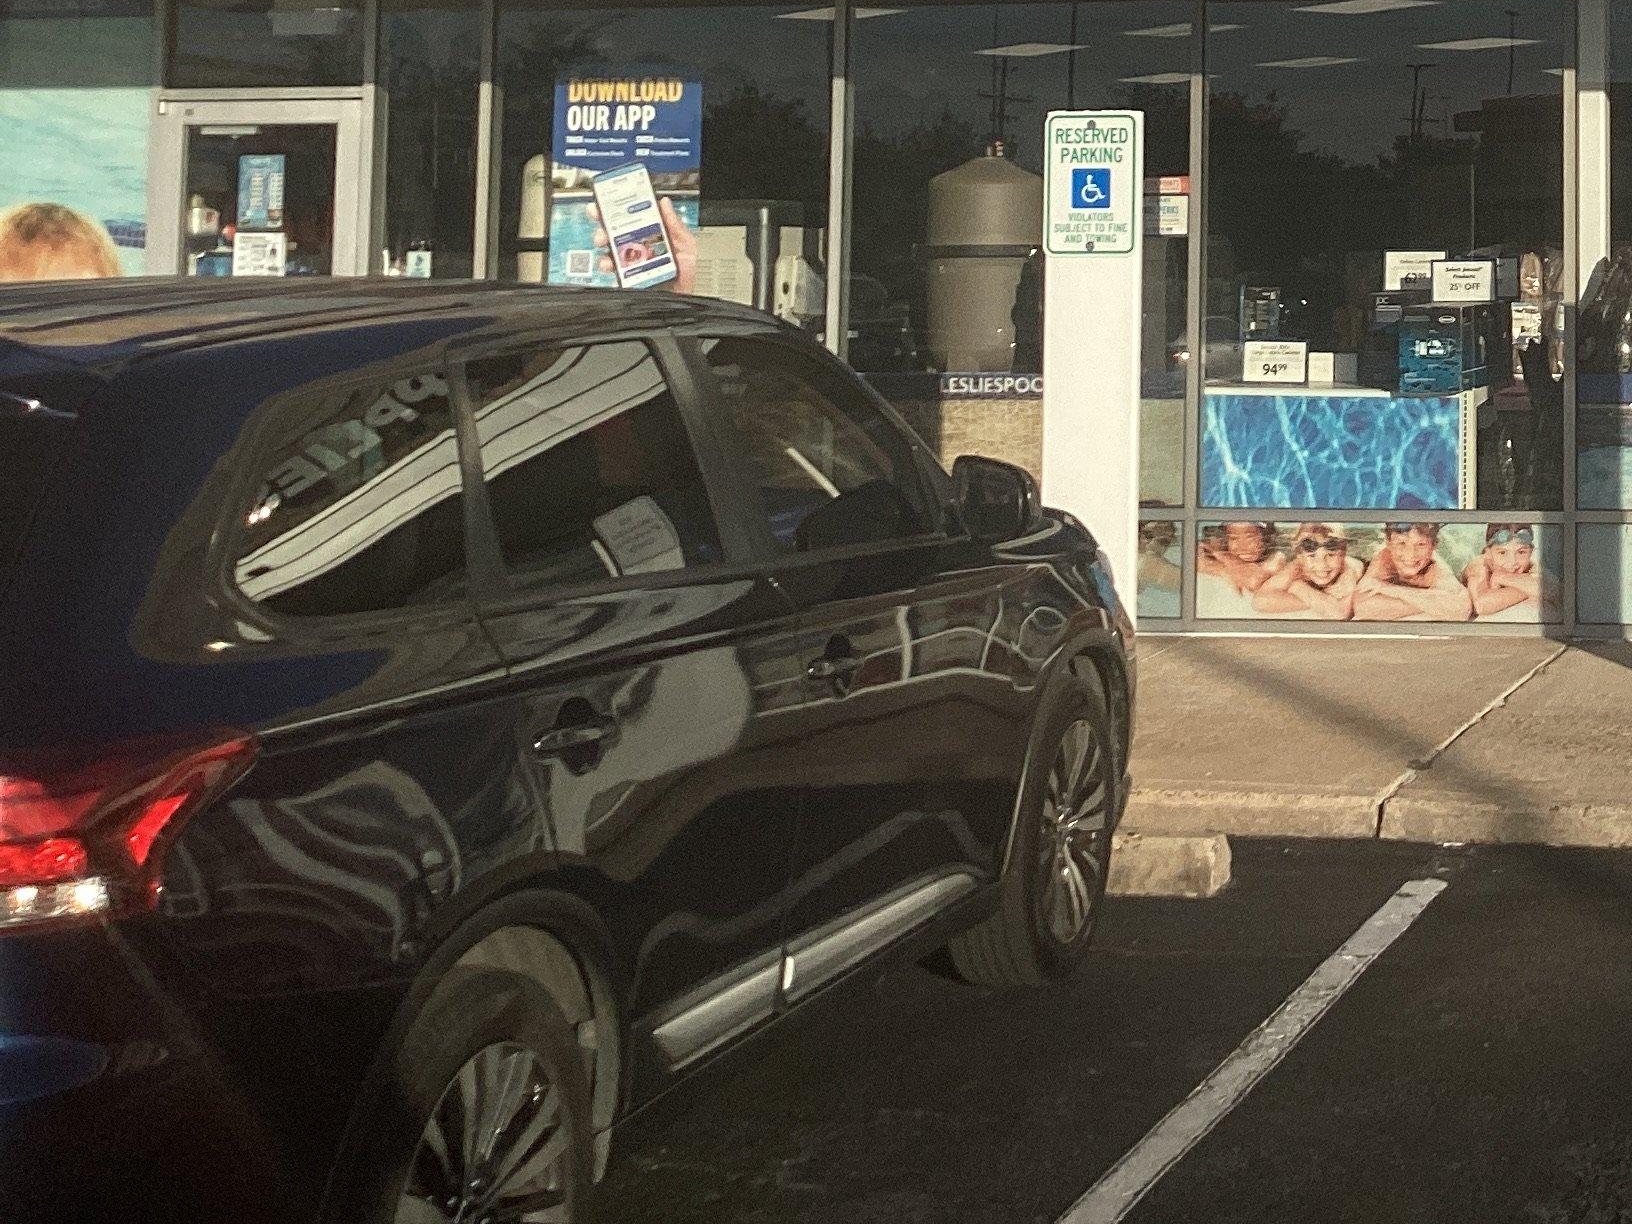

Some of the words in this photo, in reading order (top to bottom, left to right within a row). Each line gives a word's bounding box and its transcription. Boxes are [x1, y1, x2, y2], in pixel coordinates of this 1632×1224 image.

[568, 78, 684, 103] DOWNLOAD
[567, 105, 610, 131] OUR
[614, 105, 656, 131] APP
[1055, 128, 1129, 144] RESERVED
[1060, 147, 1123, 164] PARKING
[1067, 212, 1114, 222] VIOLATORS
[1054, 223, 1092, 233] SUBJECT
[1094, 223, 1105, 233] TO
[1108, 223, 1128, 233] FINE
[1063, 234, 1083, 244] AND
[1086, 234, 1117, 244] TOWING
[1464, 282, 1481, 291] OFF
